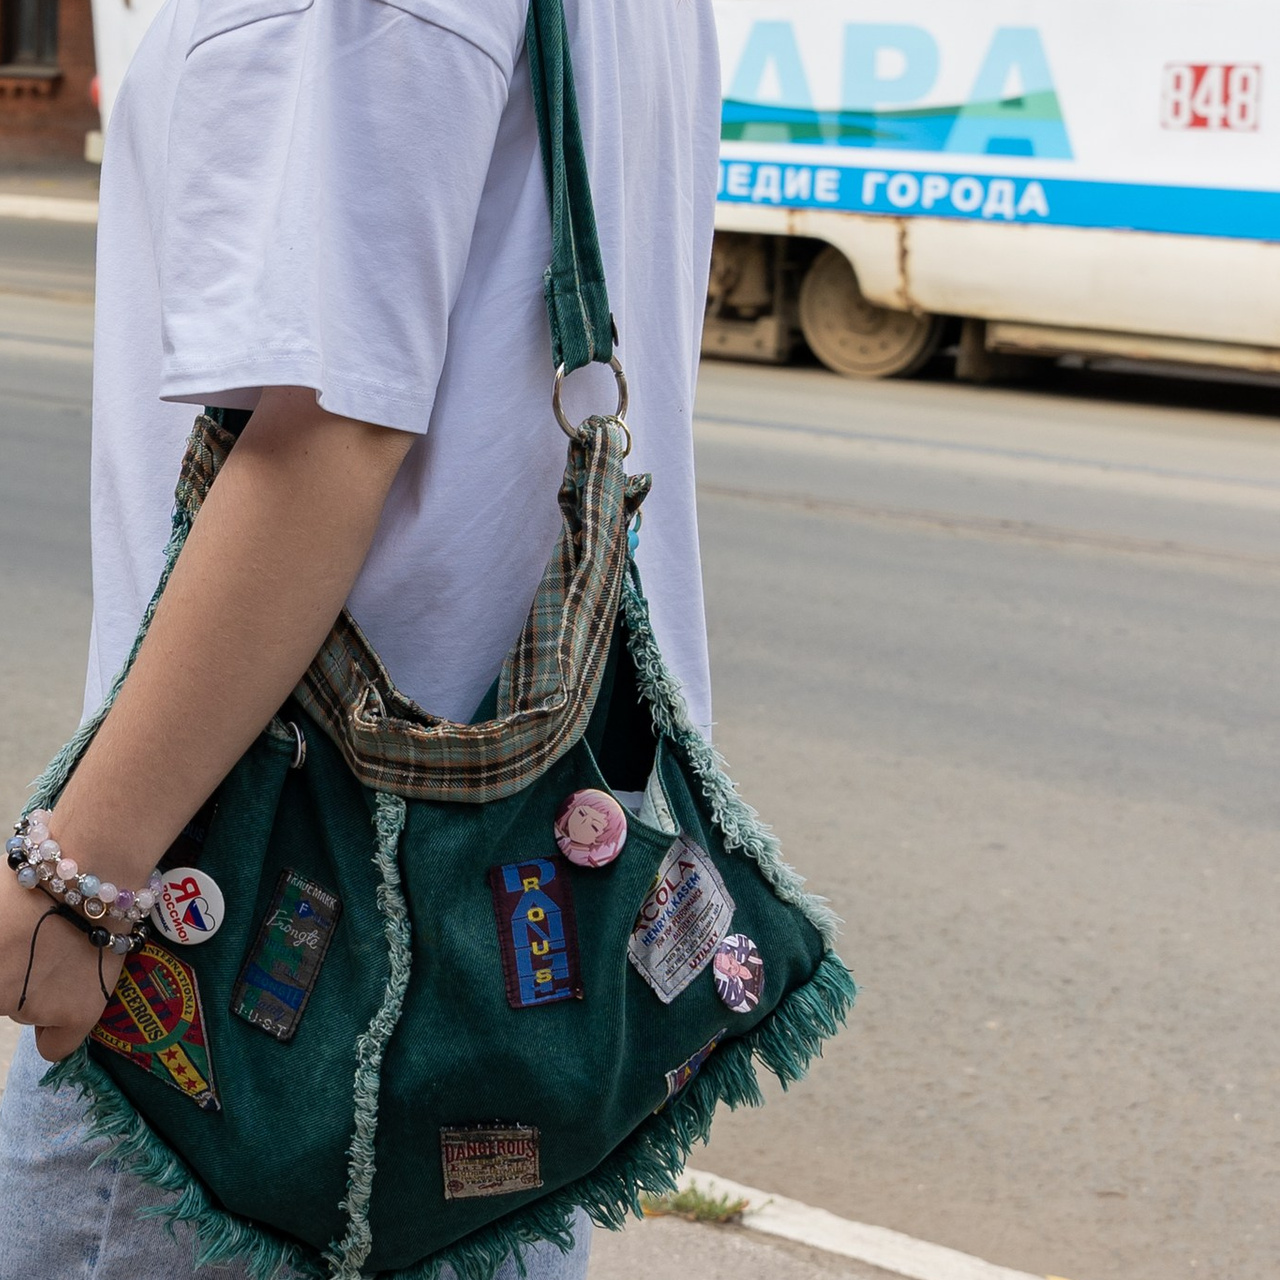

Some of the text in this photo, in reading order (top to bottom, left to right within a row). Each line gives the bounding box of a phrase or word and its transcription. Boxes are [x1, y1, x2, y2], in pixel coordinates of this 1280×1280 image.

[720, 20, 1074, 160] АРА
[1161, 62, 1262, 132] 848
[862, 172, 1049, 219] ГОРОДА
[168, 877, 201, 903] Я
[298, 903, 308, 914] F
[689, 930, 719, 969] UTILITY
[120, 973, 164, 1041] NGEROUS
[93, 1025, 130, 1050] UALITY
[445, 1140, 536, 1163] DANGEROUS
